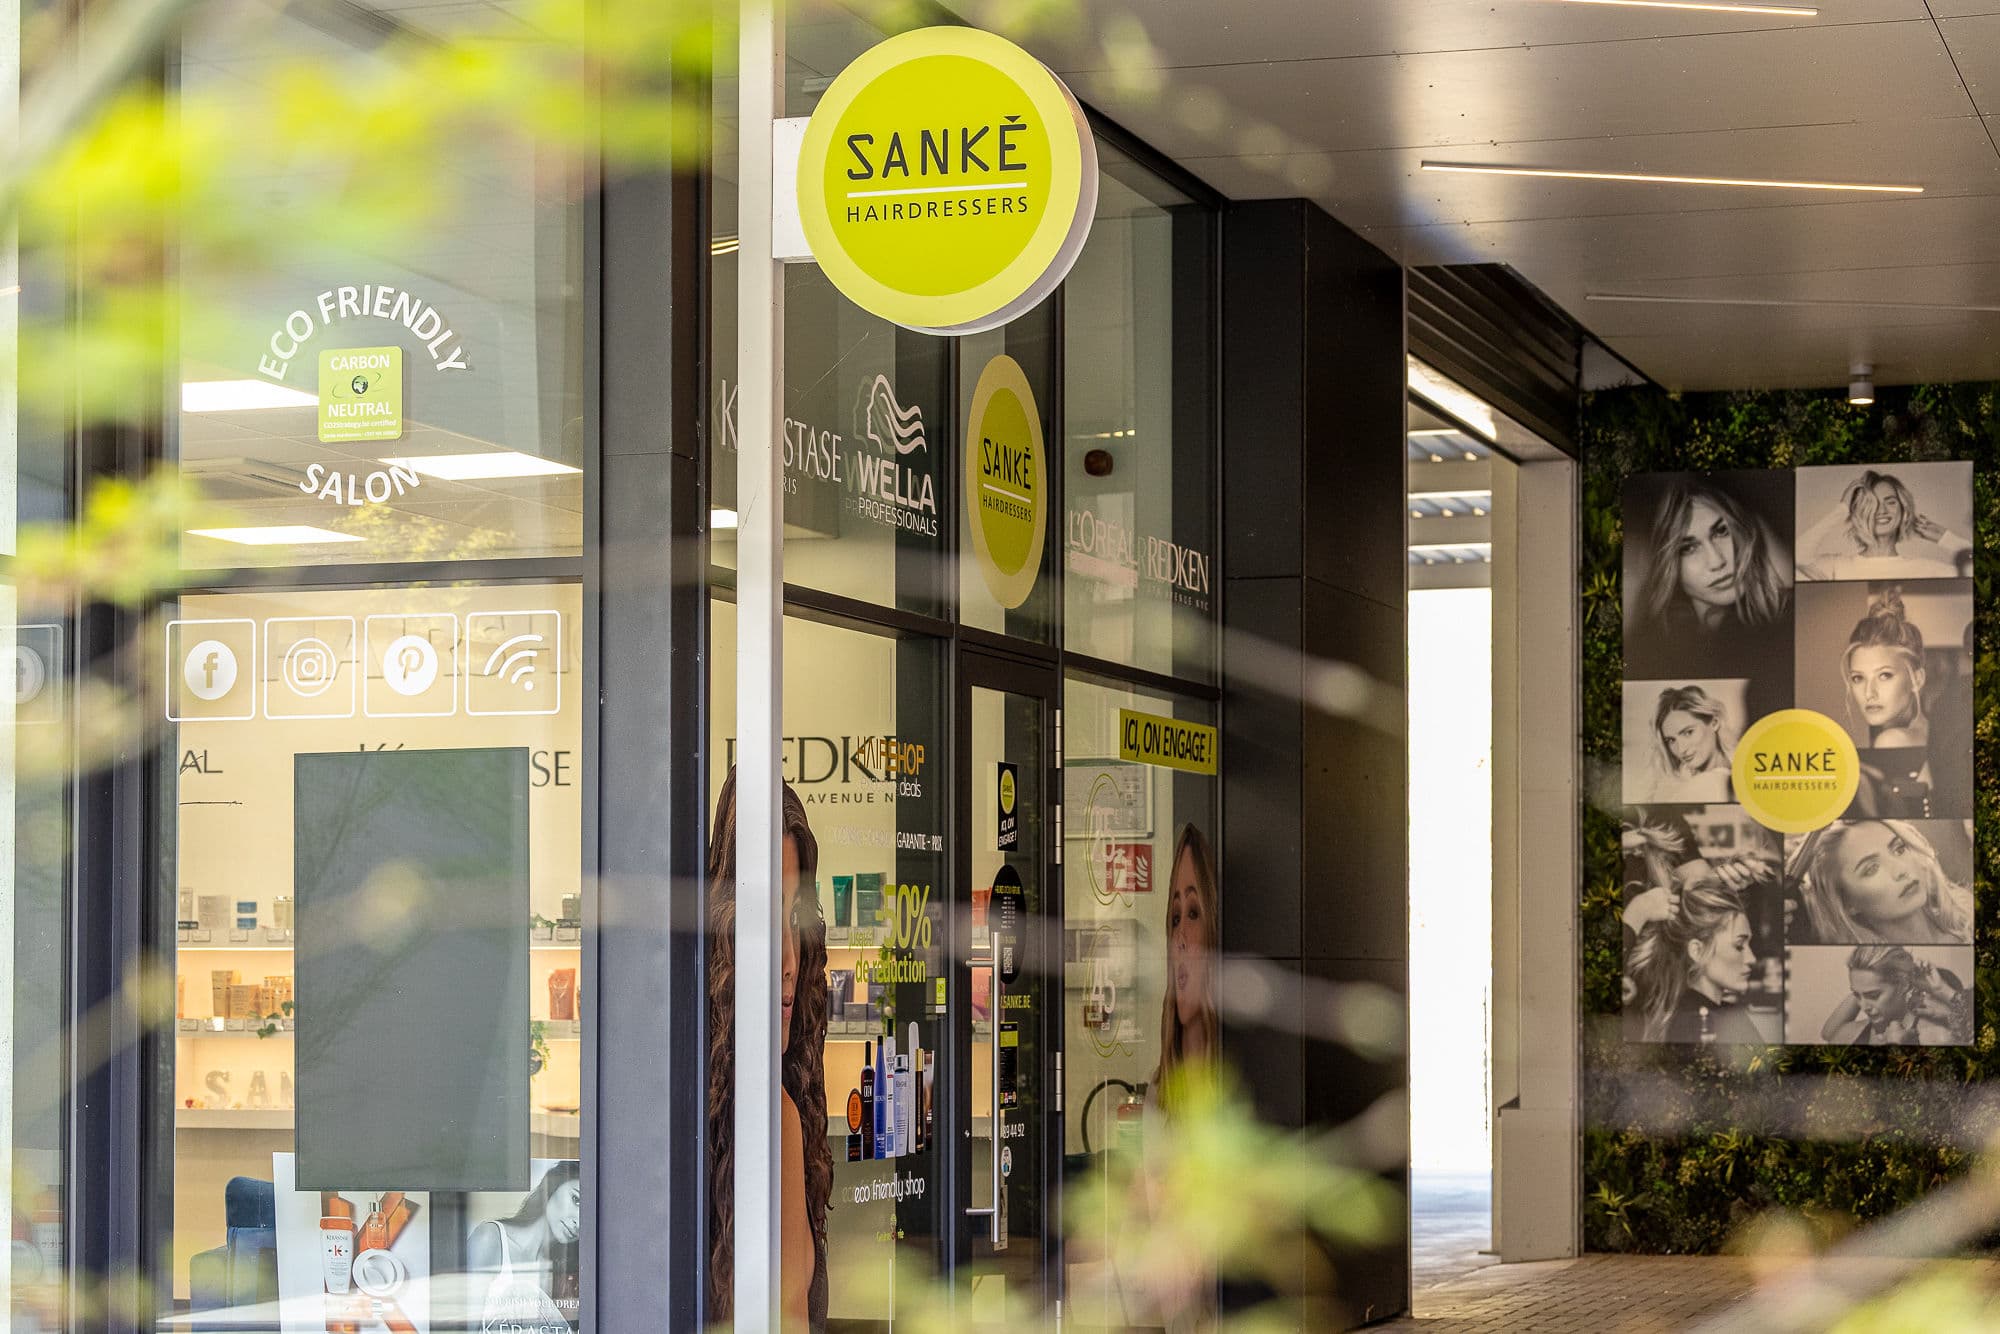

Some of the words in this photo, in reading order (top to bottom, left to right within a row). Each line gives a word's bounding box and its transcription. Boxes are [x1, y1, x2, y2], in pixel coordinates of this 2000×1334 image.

[847, 196, 1028, 223] HAIRDRESSERS
[258, 310, 314, 381] ECO
[317, 284, 467, 372] FRIENDLY
[331, 354, 391, 371] CARBON
[328, 402, 393, 418] NEUTRAL
[299, 463, 421, 506] SALON
[783, 476, 797, 495] RIS
[857, 450, 937, 515] WELLA
[858, 497, 938, 538] PROFESSIONALS
[983, 495, 1032, 522] HAIRDRESSERS
[1148, 535, 1209, 595] REDKEN
[1123, 718, 1141, 758] ICI,
[1143, 723, 1161, 755] ON
[1163, 726, 1206, 763] ENGAGE
[807, 792, 875, 804] AVENUE
[1753, 781, 1838, 791] HAIRDRESSERS
[855, 951, 869, 984] de
[855, 1185, 871, 1204] eco
[872, 1172, 904, 1203] friendly
[905, 1170, 925, 1200] shop
